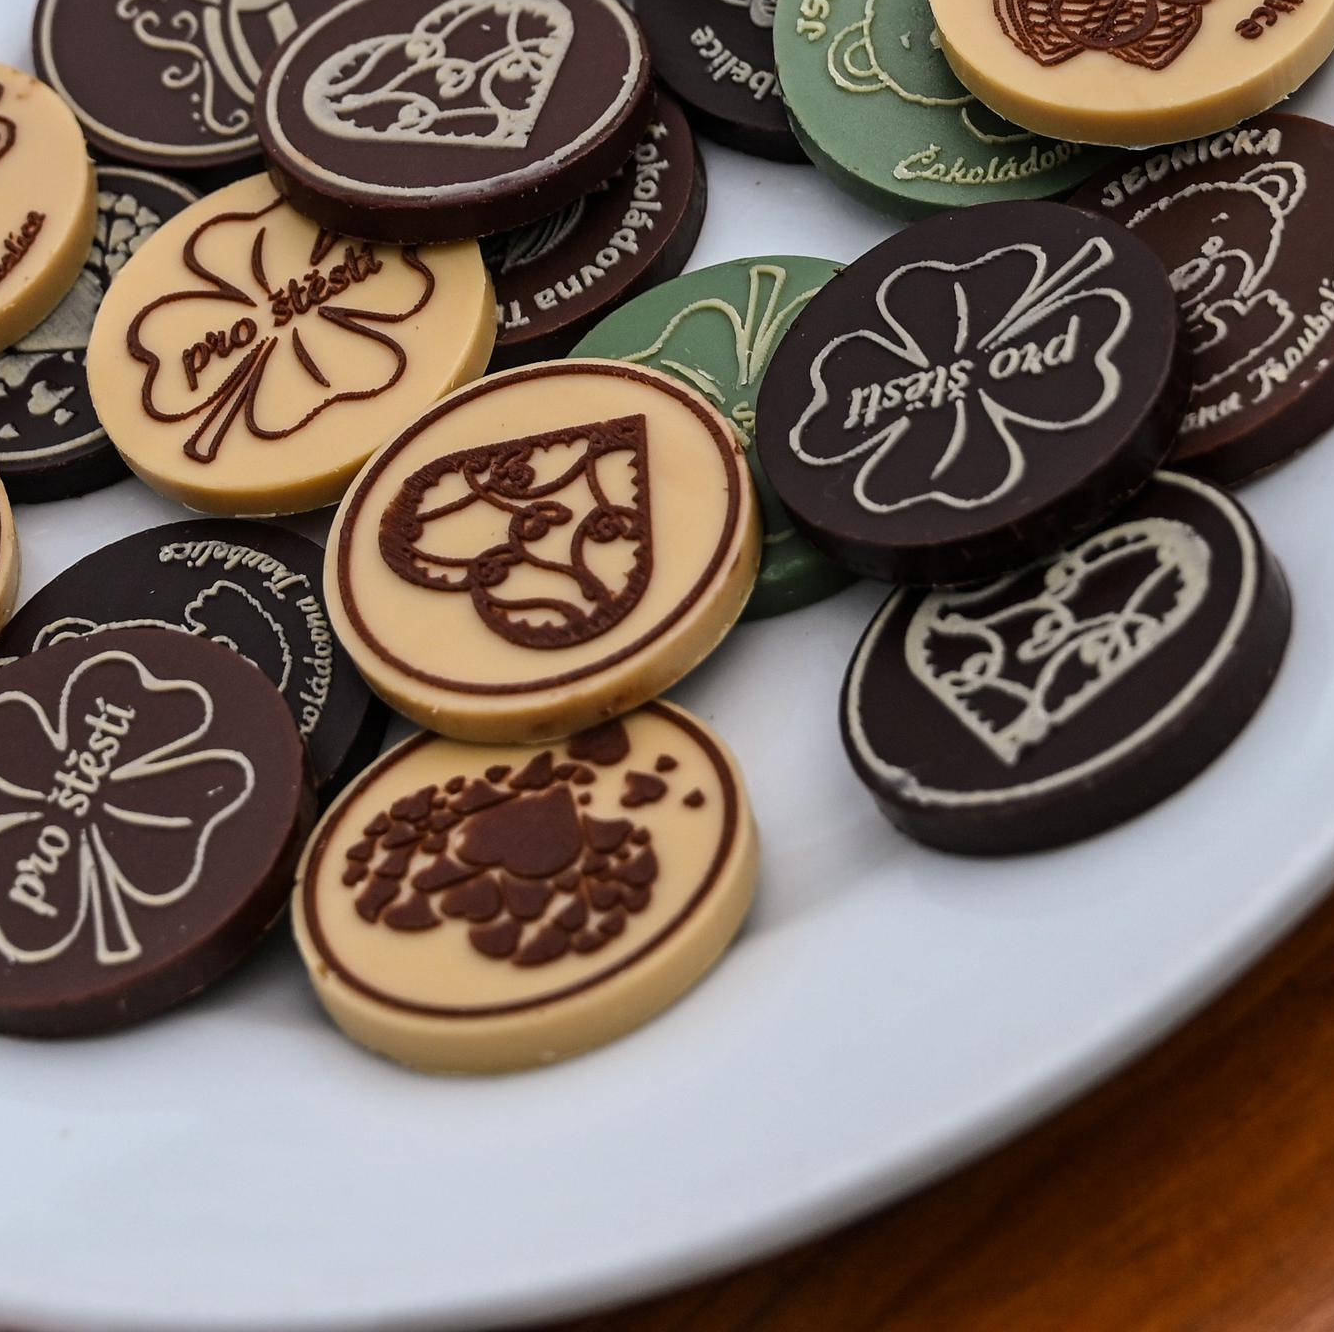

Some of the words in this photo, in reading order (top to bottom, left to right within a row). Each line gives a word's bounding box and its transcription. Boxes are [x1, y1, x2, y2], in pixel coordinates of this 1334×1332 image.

[534, 121, 669, 311] okoládovna
[181, 317, 259, 392] pro
[989, 315, 1080, 381] pro
[843, 359, 976, 430] štěstí
[9, 825, 71, 917] pro
[47, 695, 138, 817] štěstí
